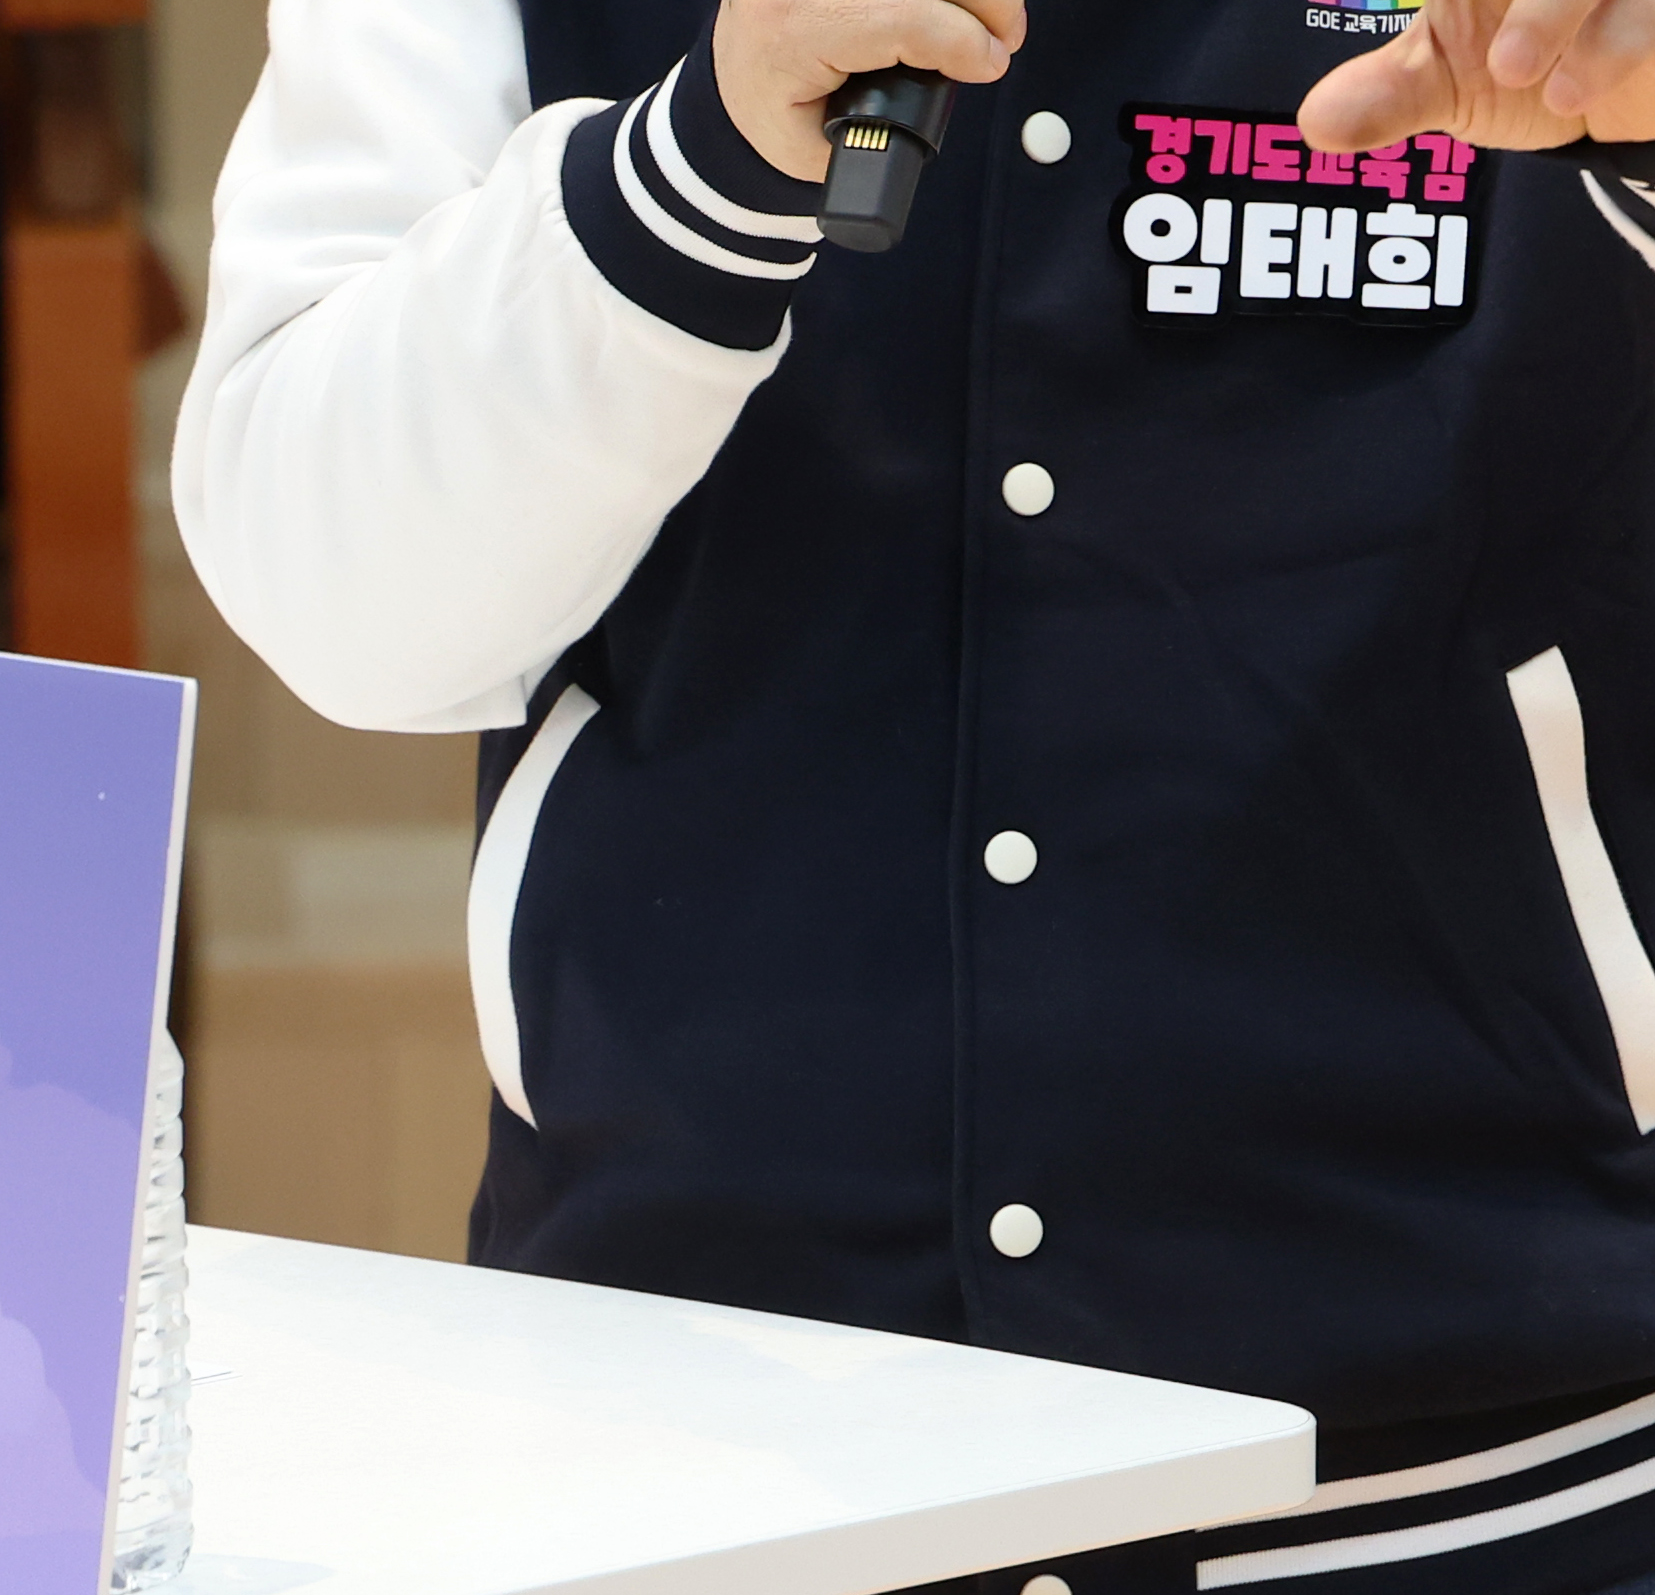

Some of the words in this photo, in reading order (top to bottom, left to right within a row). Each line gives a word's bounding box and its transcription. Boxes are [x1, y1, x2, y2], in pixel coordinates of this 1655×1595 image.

[1306, 8, 1341, 31] GOE
[1343, 13, 1418, 34] 교육기자
[1123, 192, 1469, 315] 임태희
